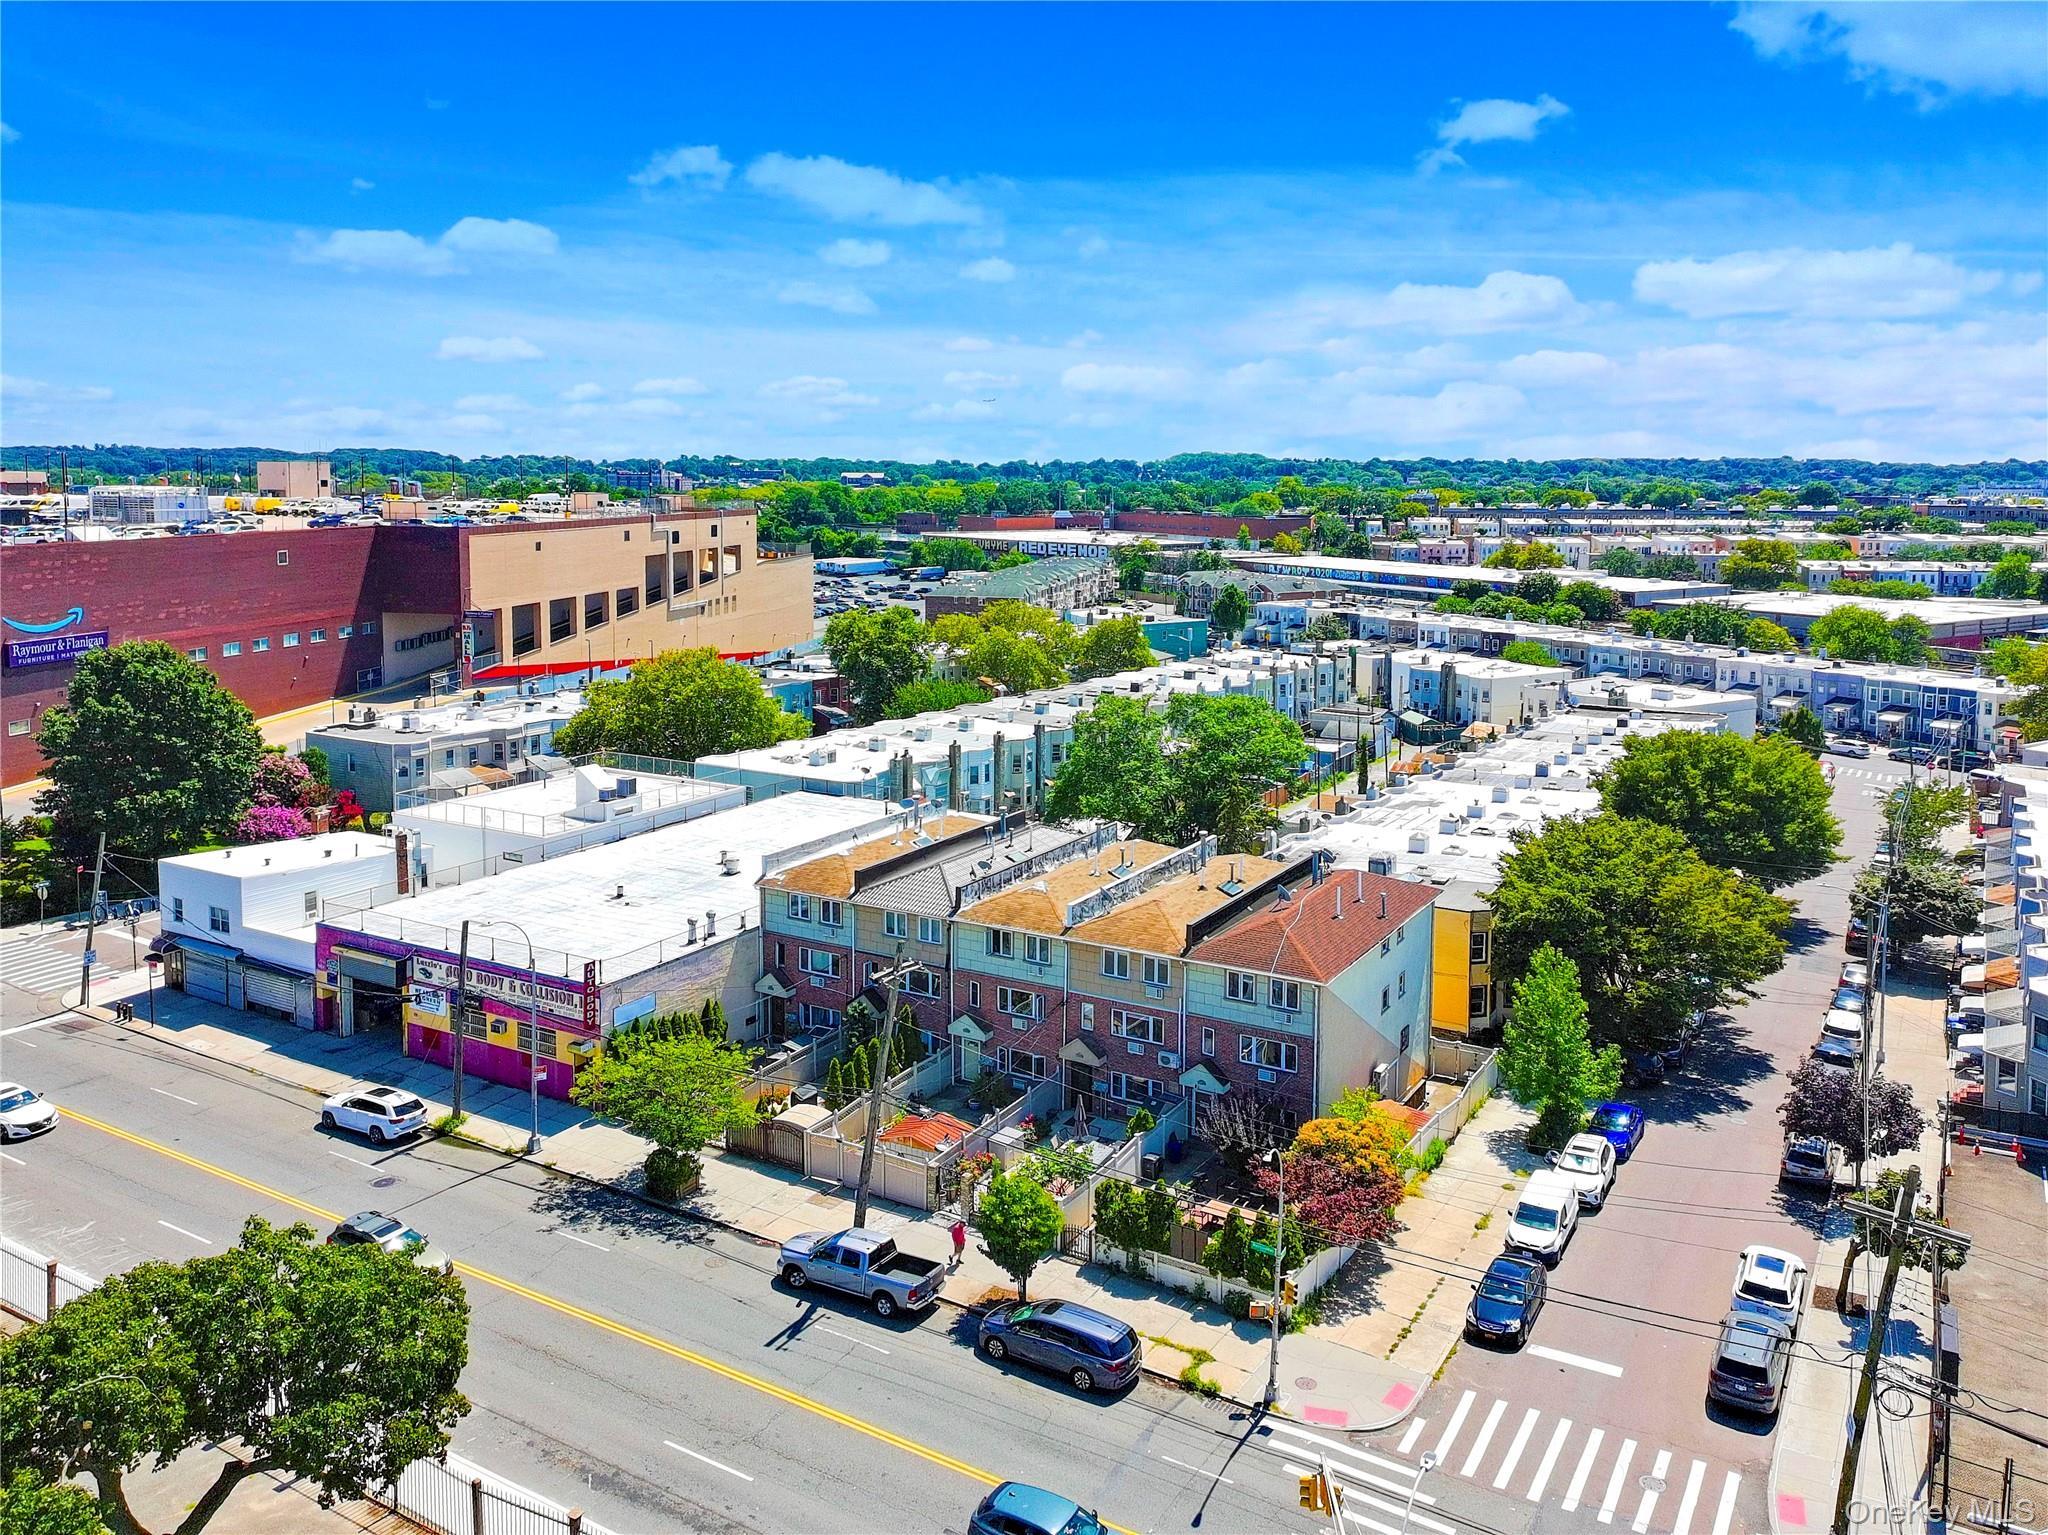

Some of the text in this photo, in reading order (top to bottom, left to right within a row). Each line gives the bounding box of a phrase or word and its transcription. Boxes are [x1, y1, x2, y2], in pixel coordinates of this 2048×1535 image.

[12, 635, 104, 658] Raymour & Flanigan
[18, 654, 55, 665] FURNITURE
[476, 972, 505, 990] BODY
[509, 980, 516, 993] &
[586, 963, 595, 1026] AUTO BODY
